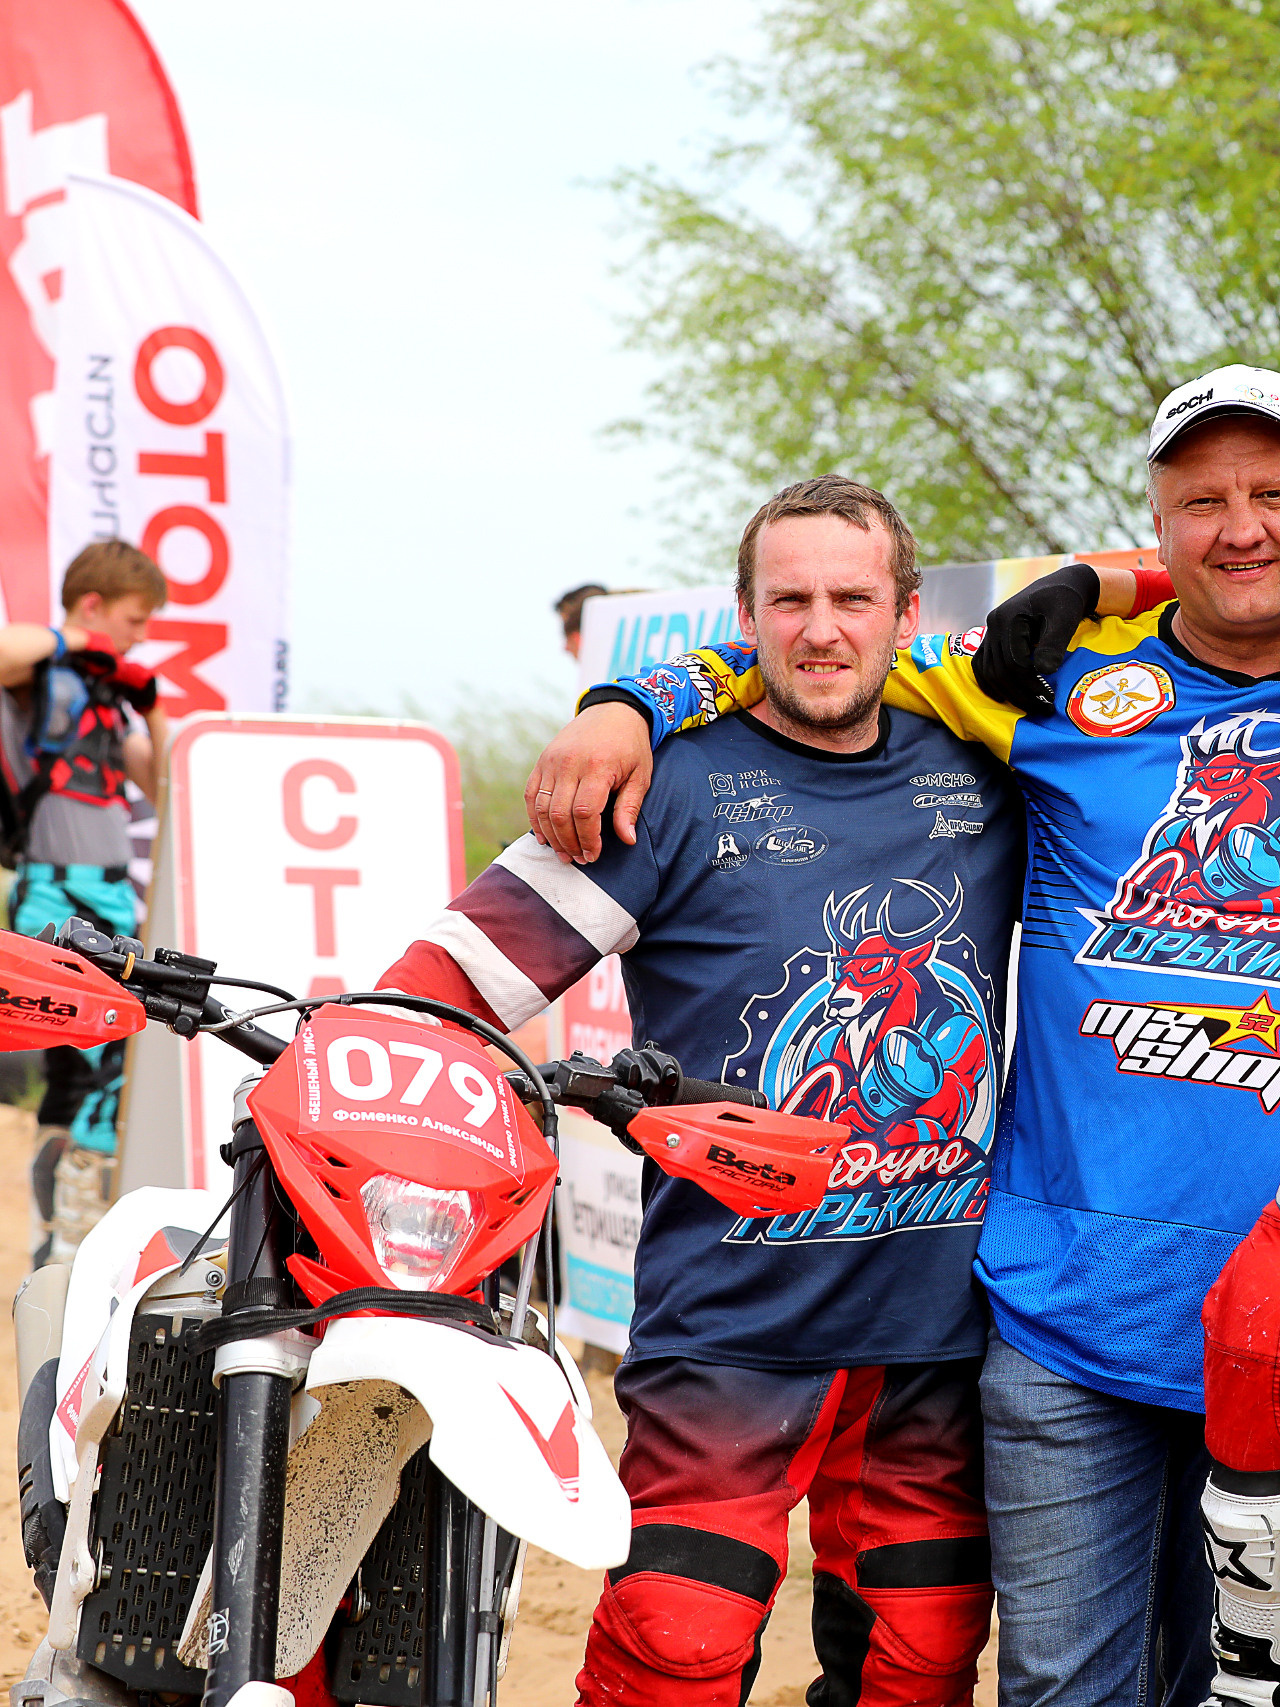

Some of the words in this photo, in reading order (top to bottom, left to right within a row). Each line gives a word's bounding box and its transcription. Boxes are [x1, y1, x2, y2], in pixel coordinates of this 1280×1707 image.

[1166, 388, 1214, 419] SOCHI
[737, 769, 768, 780] ЗВУК
[281, 758, 362, 1000] СТ
[0, 1008, 70, 1026] ACTORY
[326, 1035, 498, 1129] 079
[332, 1108, 419, 1127] Фоменко
[421, 1116, 505, 1160] Александр
[706, 1144, 797, 1187] Beta
[708, 1165, 788, 1192] FACTORY
